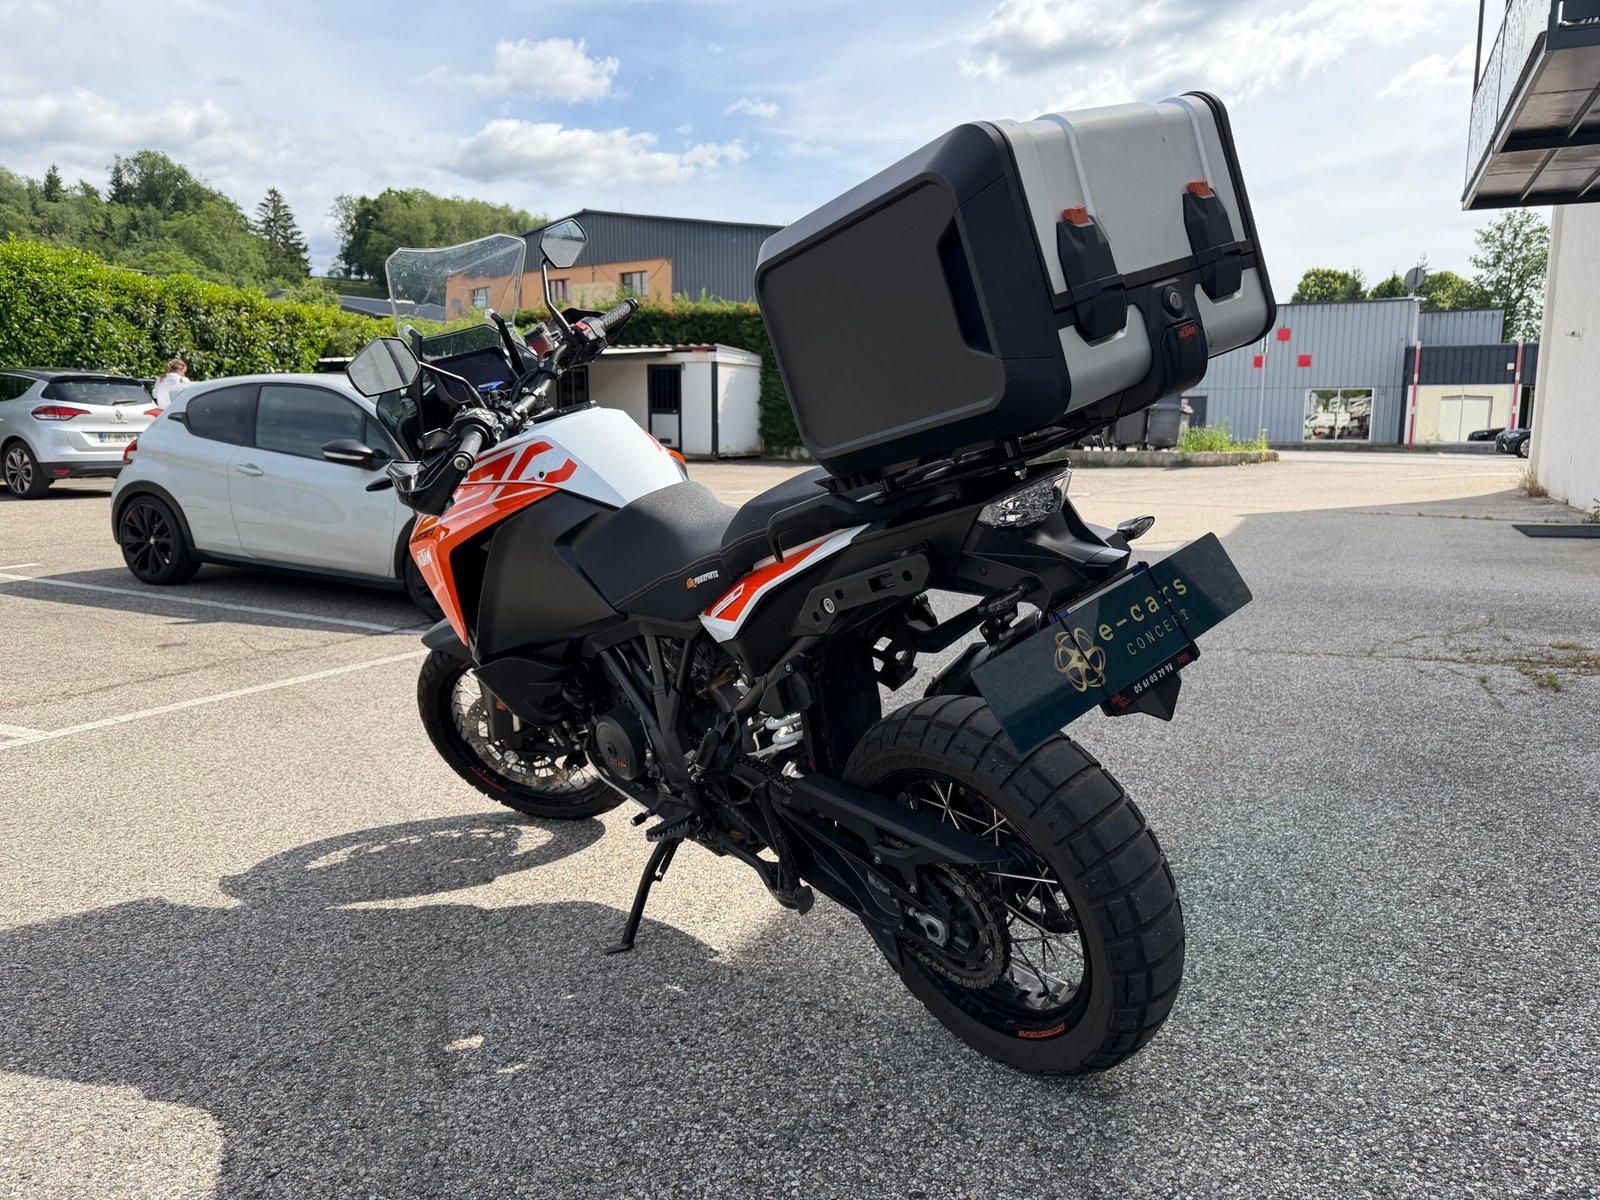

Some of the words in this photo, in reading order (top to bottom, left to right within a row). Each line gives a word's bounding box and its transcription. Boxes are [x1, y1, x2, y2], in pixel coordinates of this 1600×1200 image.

[417, 548, 432, 567] KTM
[1098, 578, 1187, 641] e-cars
[1133, 682, 1143, 694] 05
[1142, 678, 1150, 688] 61
[1149, 672, 1158, 684] 05
[1157, 668, 1166, 678] 29
